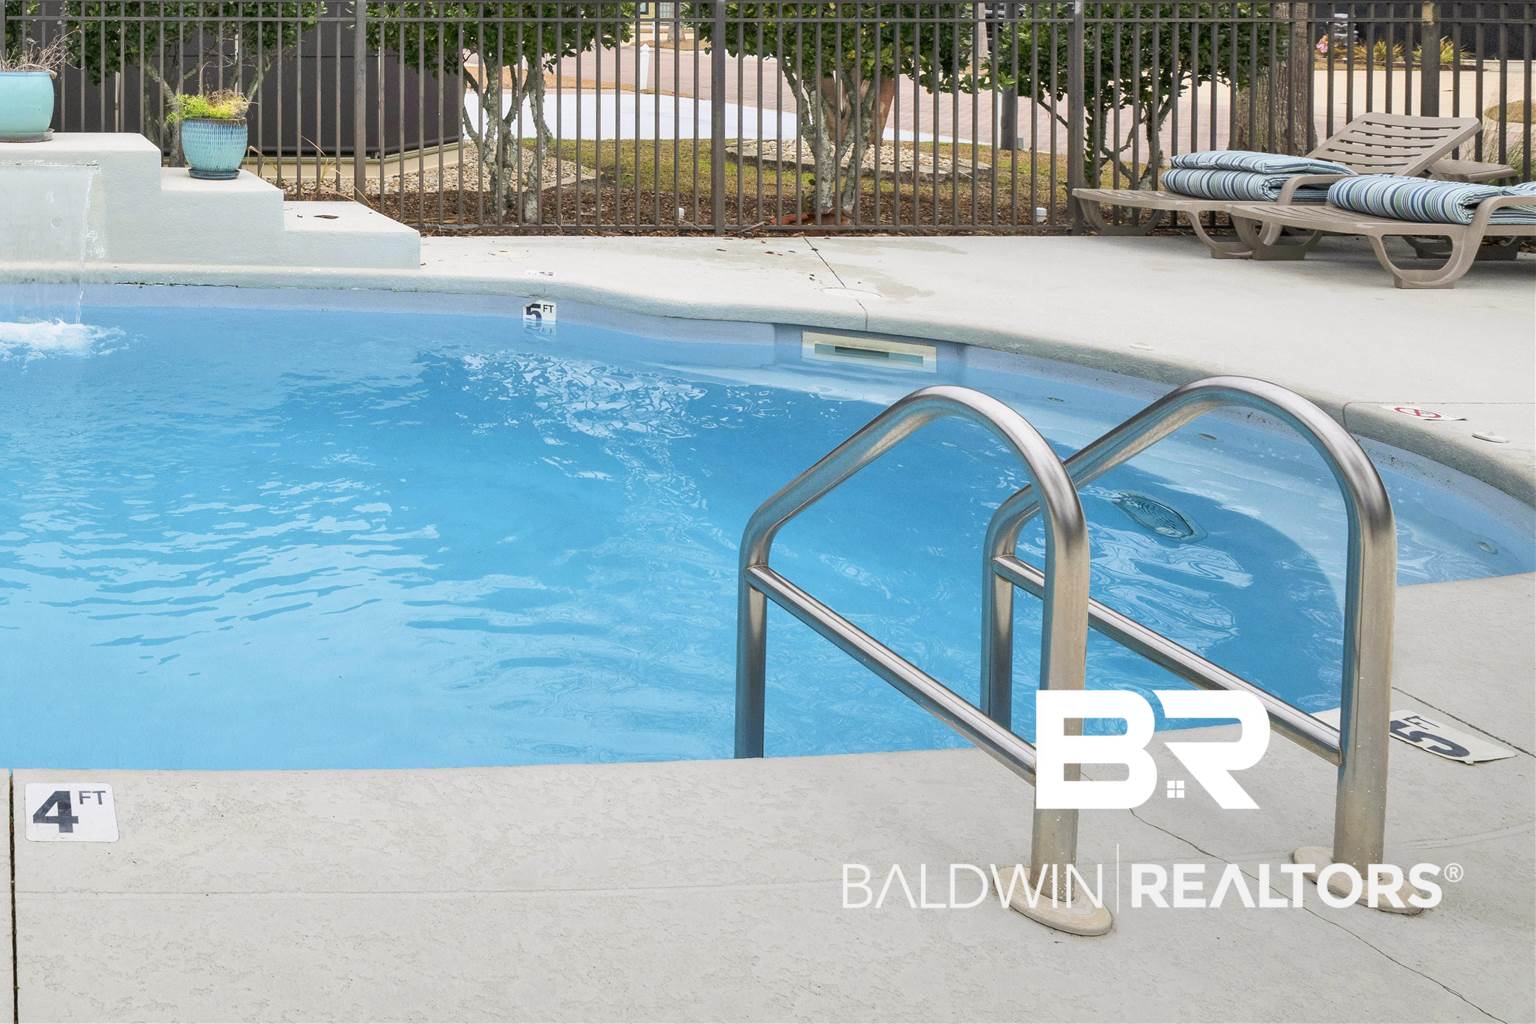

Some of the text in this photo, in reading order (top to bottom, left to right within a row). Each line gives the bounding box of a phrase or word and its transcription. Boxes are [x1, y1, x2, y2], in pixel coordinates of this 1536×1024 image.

[526, 303, 554, 323] 5 FT
[1390, 720, 1470, 758] 5
[33, 790, 106, 833] 4 FT
